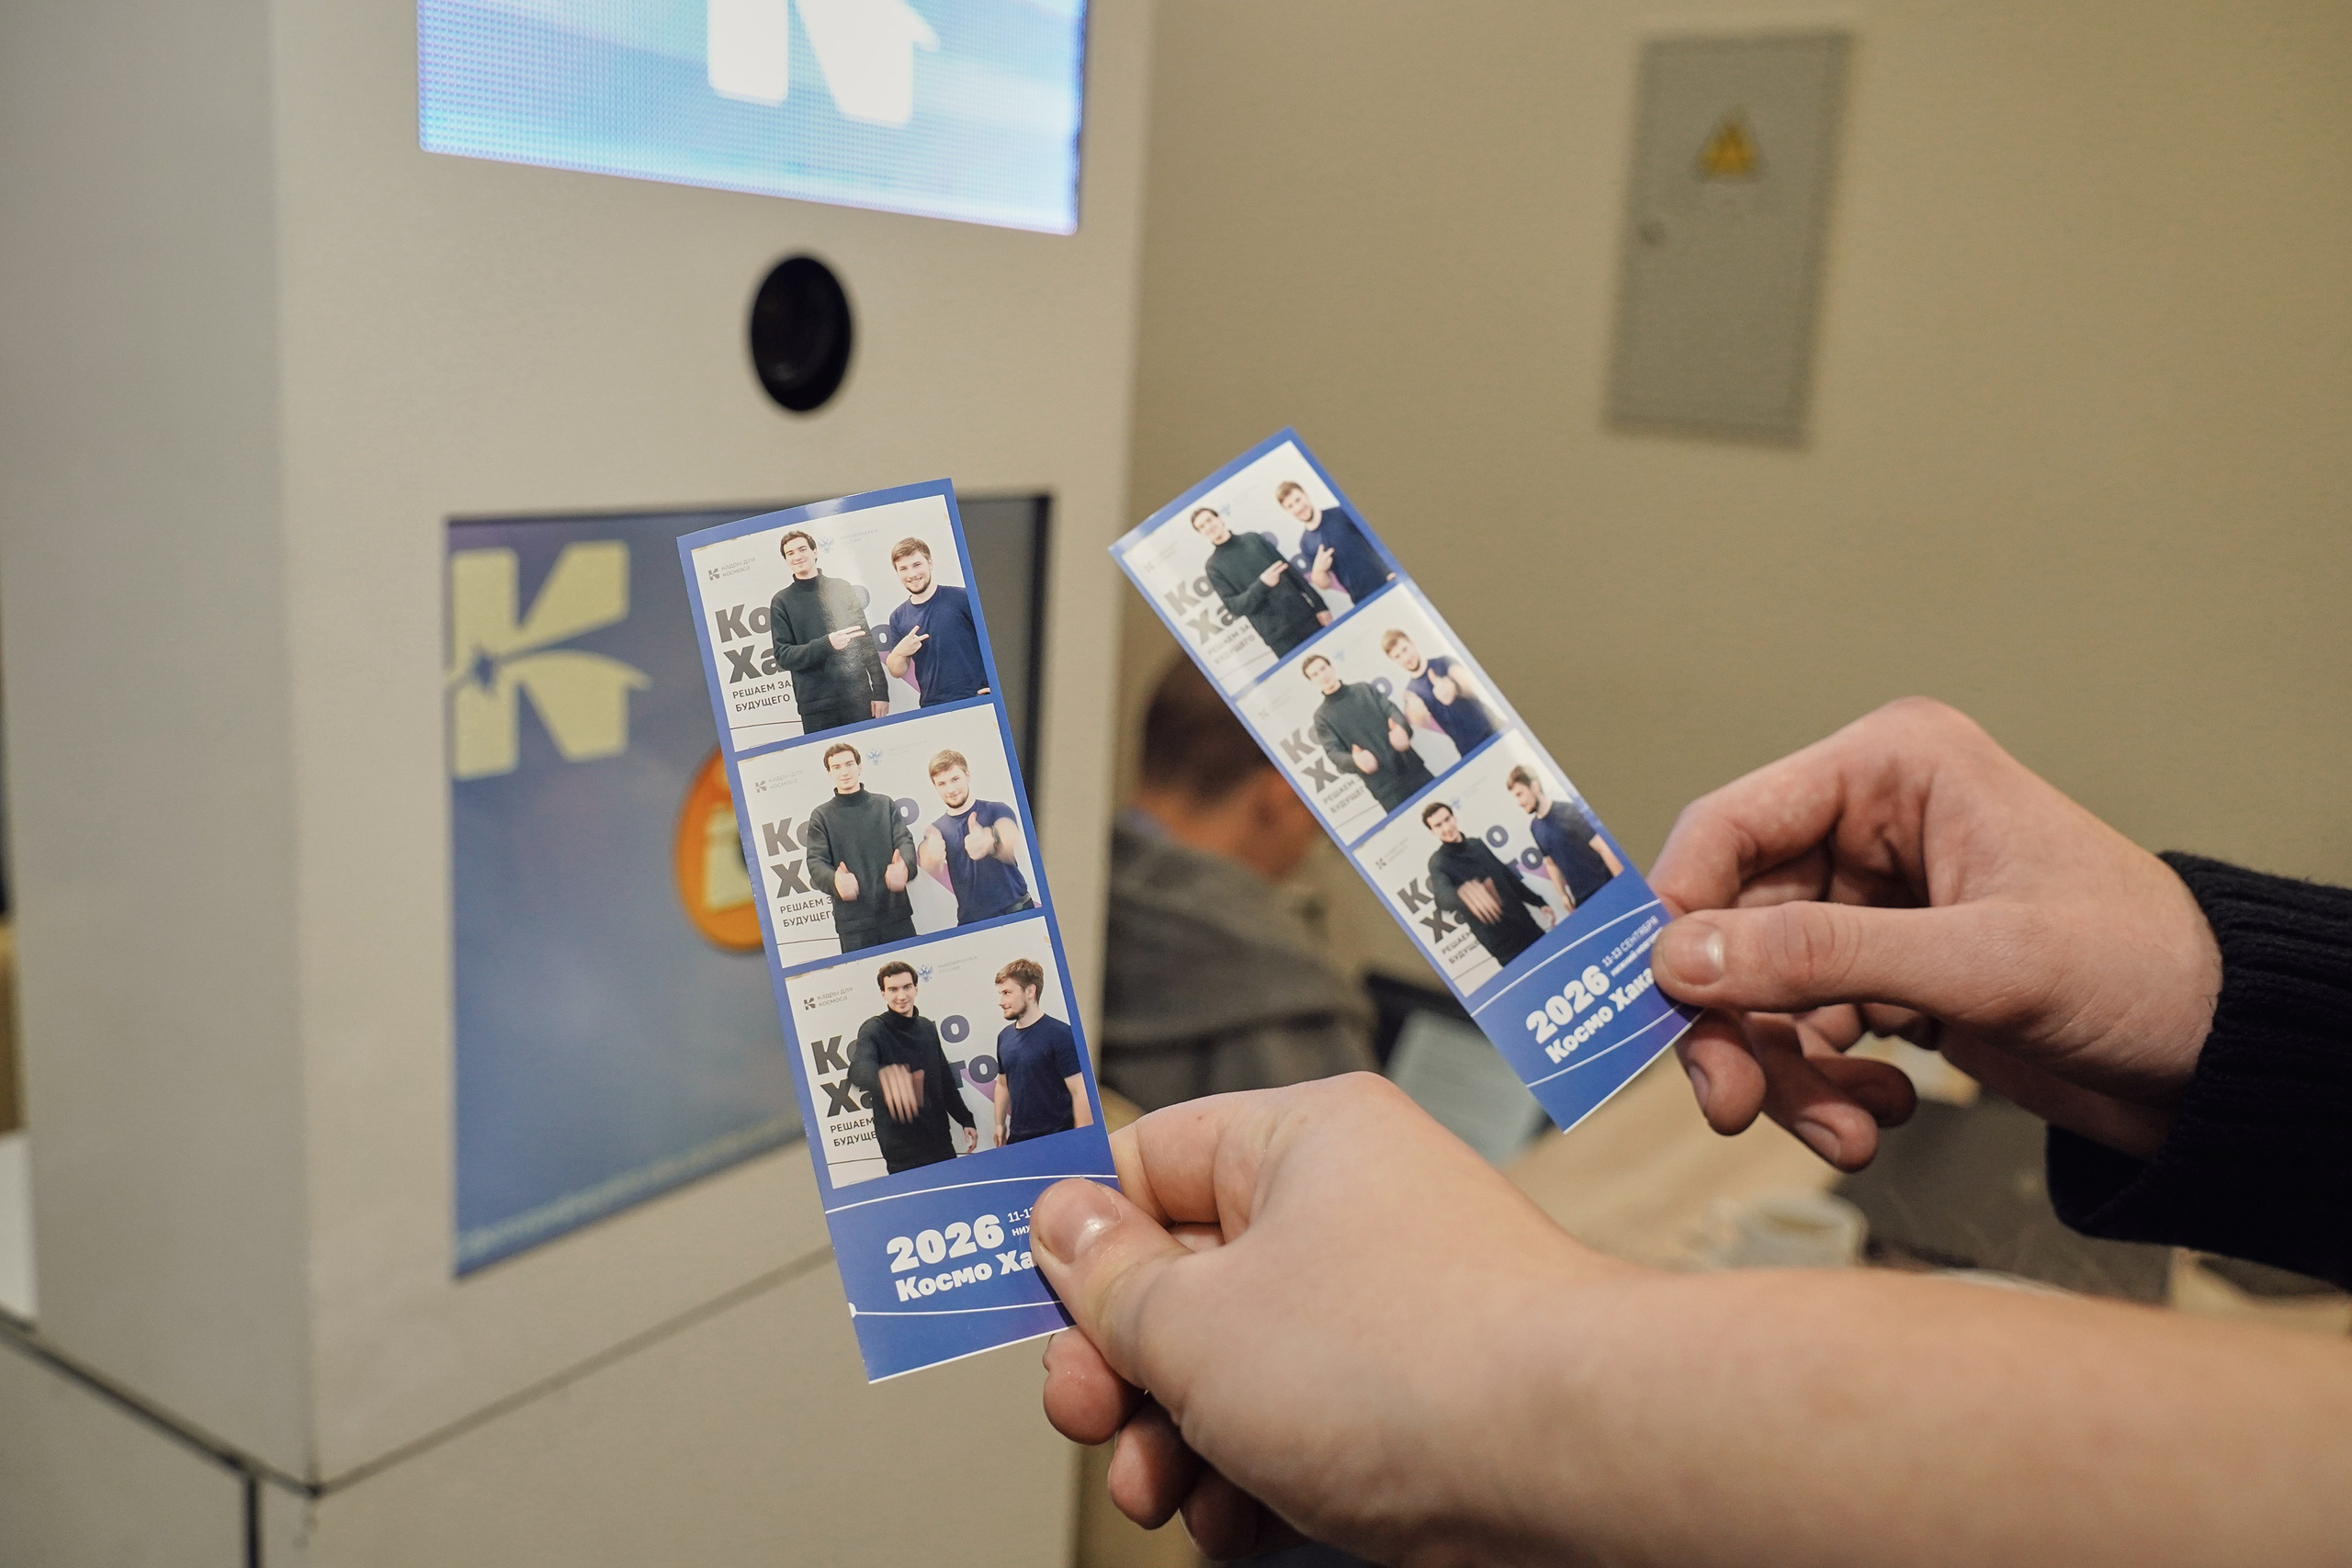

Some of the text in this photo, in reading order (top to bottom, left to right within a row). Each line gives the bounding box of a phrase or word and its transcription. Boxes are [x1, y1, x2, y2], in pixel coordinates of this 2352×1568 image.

[732, 682, 775, 698] РЕШАЕМ
[735, 694, 790, 712] БУДУЩЕГО
[780, 897, 824, 914] РЕШАЕМ
[783, 910, 833, 927] БУДУЩЕГ
[1525, 964, 1610, 1044] 2026
[1601, 947, 1623, 967] 11-13
[1544, 1006, 1613, 1065] Космо
[833, 1131, 877, 1146] БУДУЩЕ
[887, 1206, 1033, 1273] 2026 11-1
[895, 1262, 992, 1302] Космо
